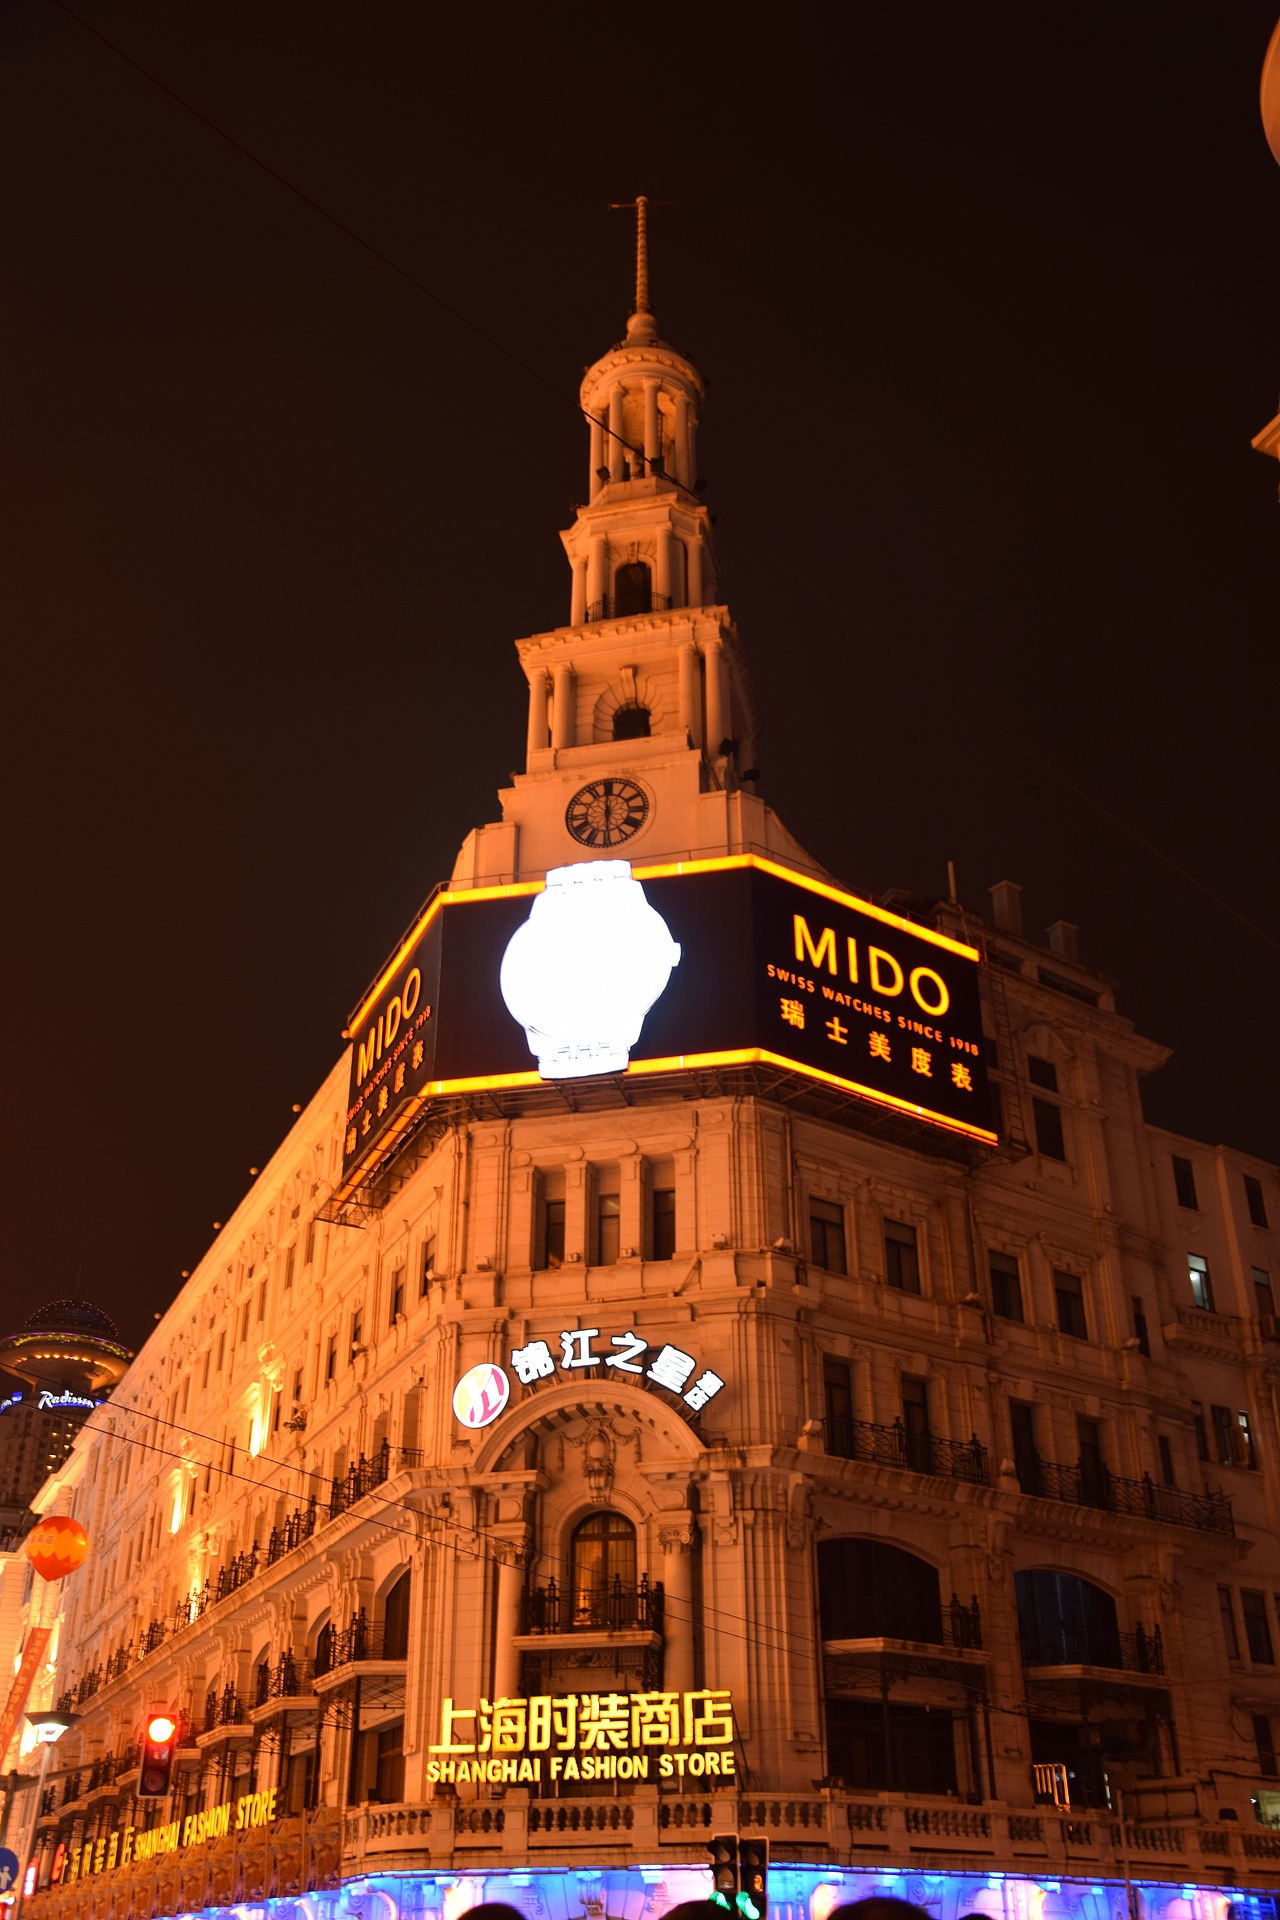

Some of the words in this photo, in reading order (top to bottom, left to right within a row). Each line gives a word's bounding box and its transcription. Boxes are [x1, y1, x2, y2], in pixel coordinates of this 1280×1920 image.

[793, 914, 949, 1017] MIDO
[357, 967, 421, 1087] MIDO
[767, 964, 815, 993] SWISS
[821, 985, 891, 1024] WATCHES
[897, 1016, 943, 1043] SINCE
[949, 1036, 980, 1057] 1918
[780, 997, 973, 1092] 瑞士美度表
[511, 1328, 697, 1395] 锦江之星
[38, 1389, 95, 1410] Radisson
[428, 1690, 735, 1754] 上海时装商店
[425, 1758, 541, 1784] SHANGHAI
[550, 1754, 649, 1781] FASHION
[658, 1750, 736, 1778] STORE
[133, 1821, 181, 1861] SHANGHAI
[183, 1802, 231, 1848] FASHION
[235, 1787, 278, 1831] STORE
